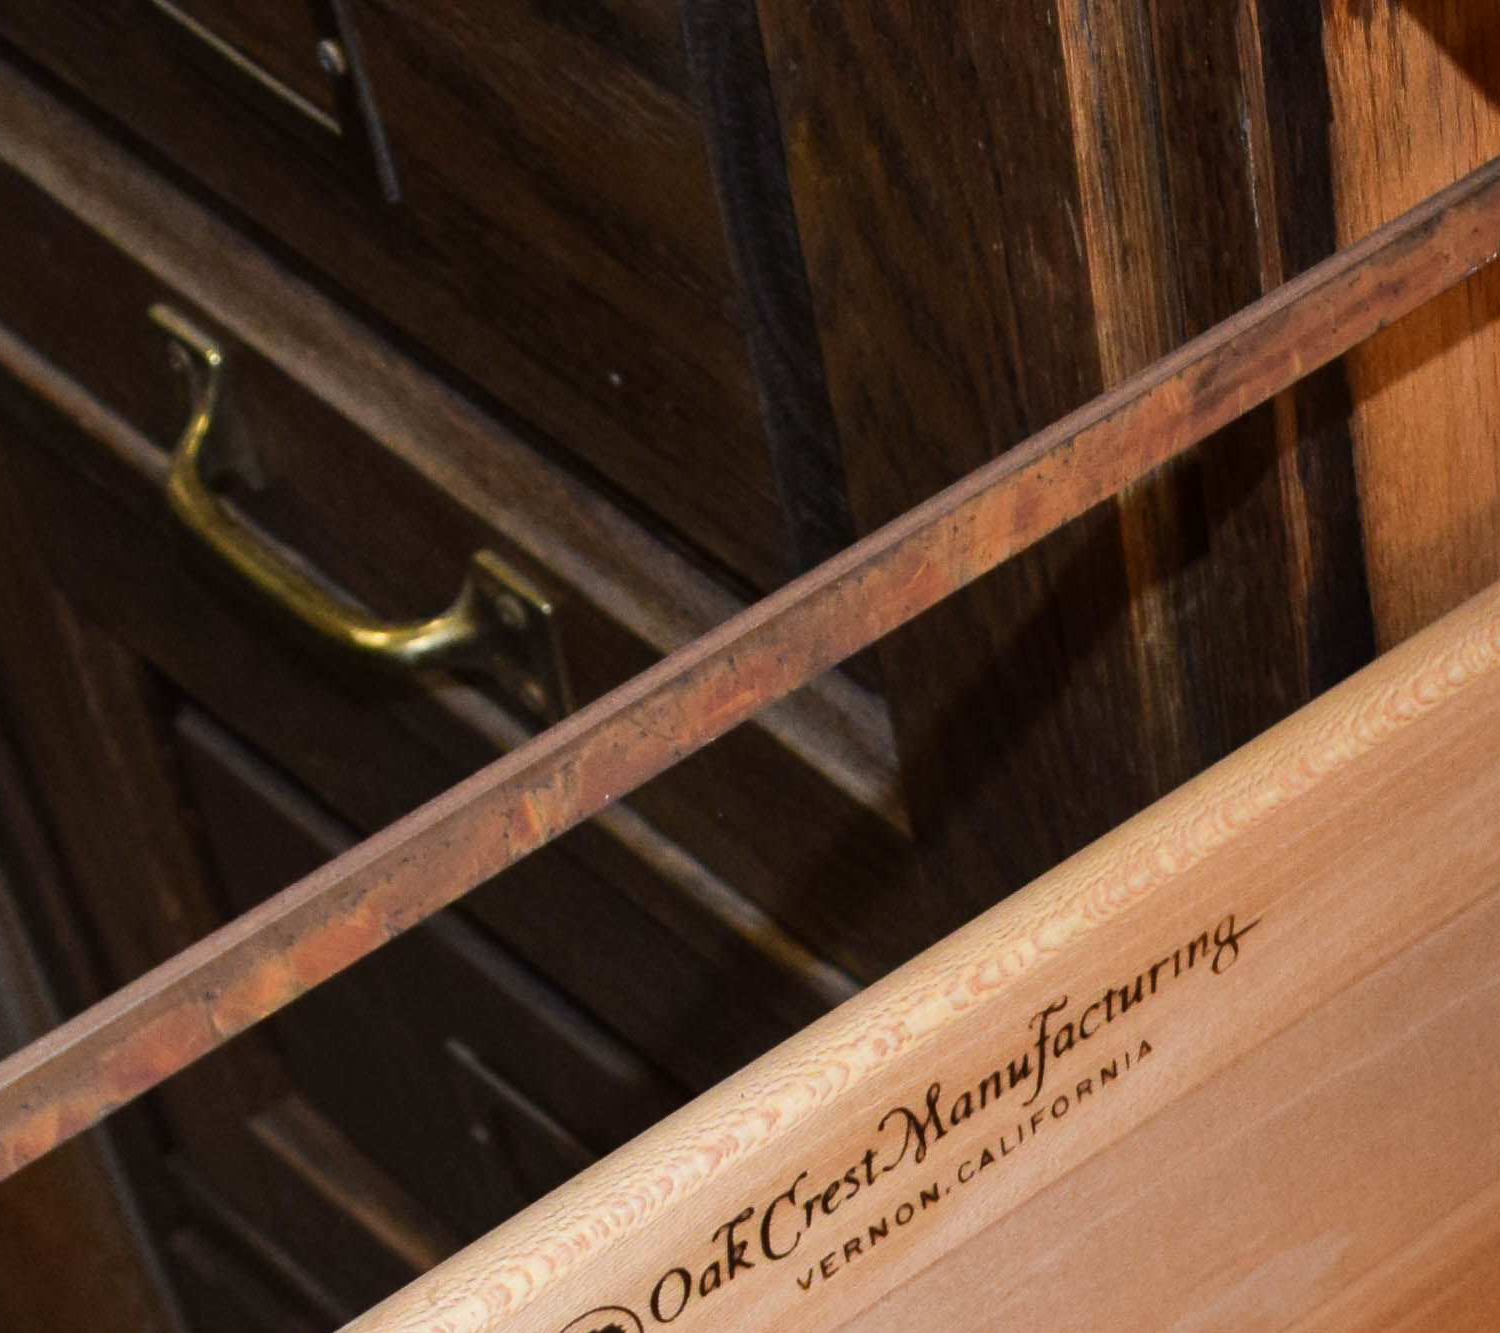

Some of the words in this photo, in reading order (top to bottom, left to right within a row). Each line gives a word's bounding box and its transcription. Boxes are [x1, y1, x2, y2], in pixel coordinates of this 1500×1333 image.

[648, 1208, 758, 1324] Oak
[758, 1150, 879, 1262] Crest
[878, 914, 1263, 1172] Manufacturing
[957, 1038, 1156, 1185] CALIFORNIA
